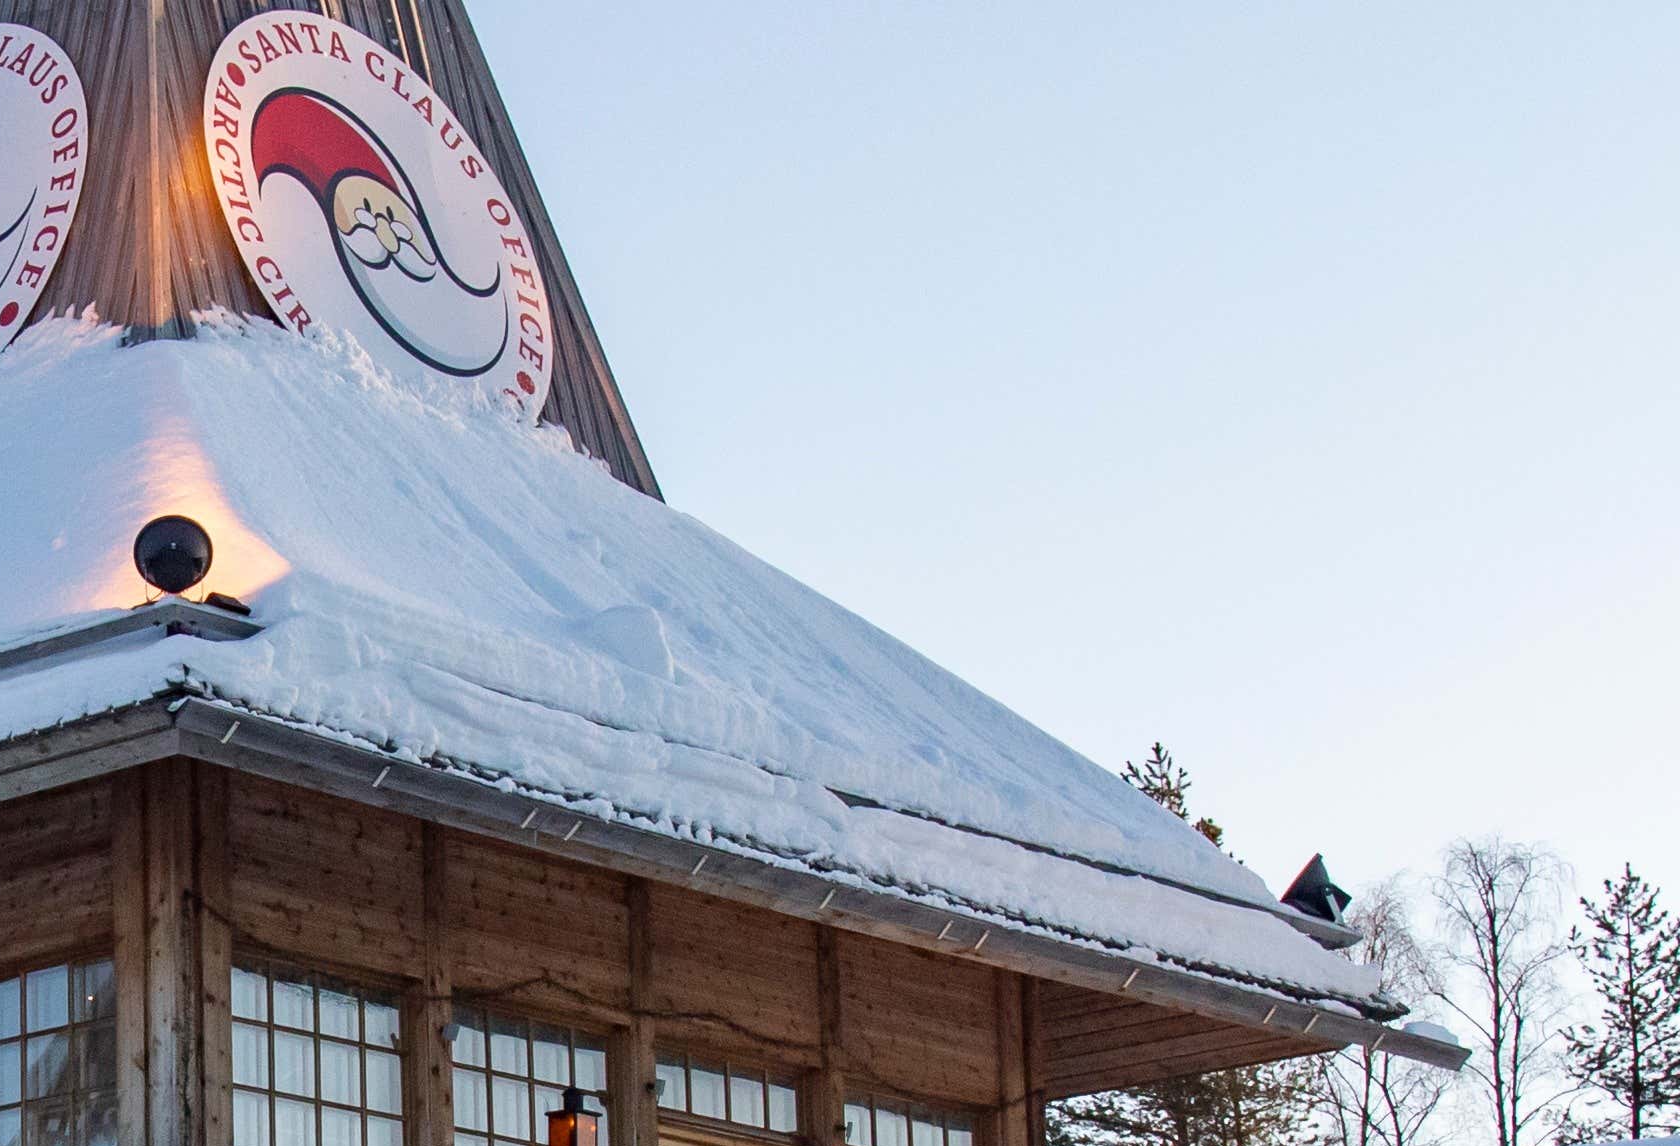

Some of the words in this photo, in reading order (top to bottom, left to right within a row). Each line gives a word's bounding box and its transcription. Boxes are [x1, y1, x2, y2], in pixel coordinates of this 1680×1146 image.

[16, 107, 79, 289] OFFICE
[213, 77, 264, 245] ARCTIC
[255, 255, 313, 337] CIR
[239, 22, 352, 73] SANTA
[365, 51, 484, 180] CLAUS
[486, 198, 545, 372] OFFICE
